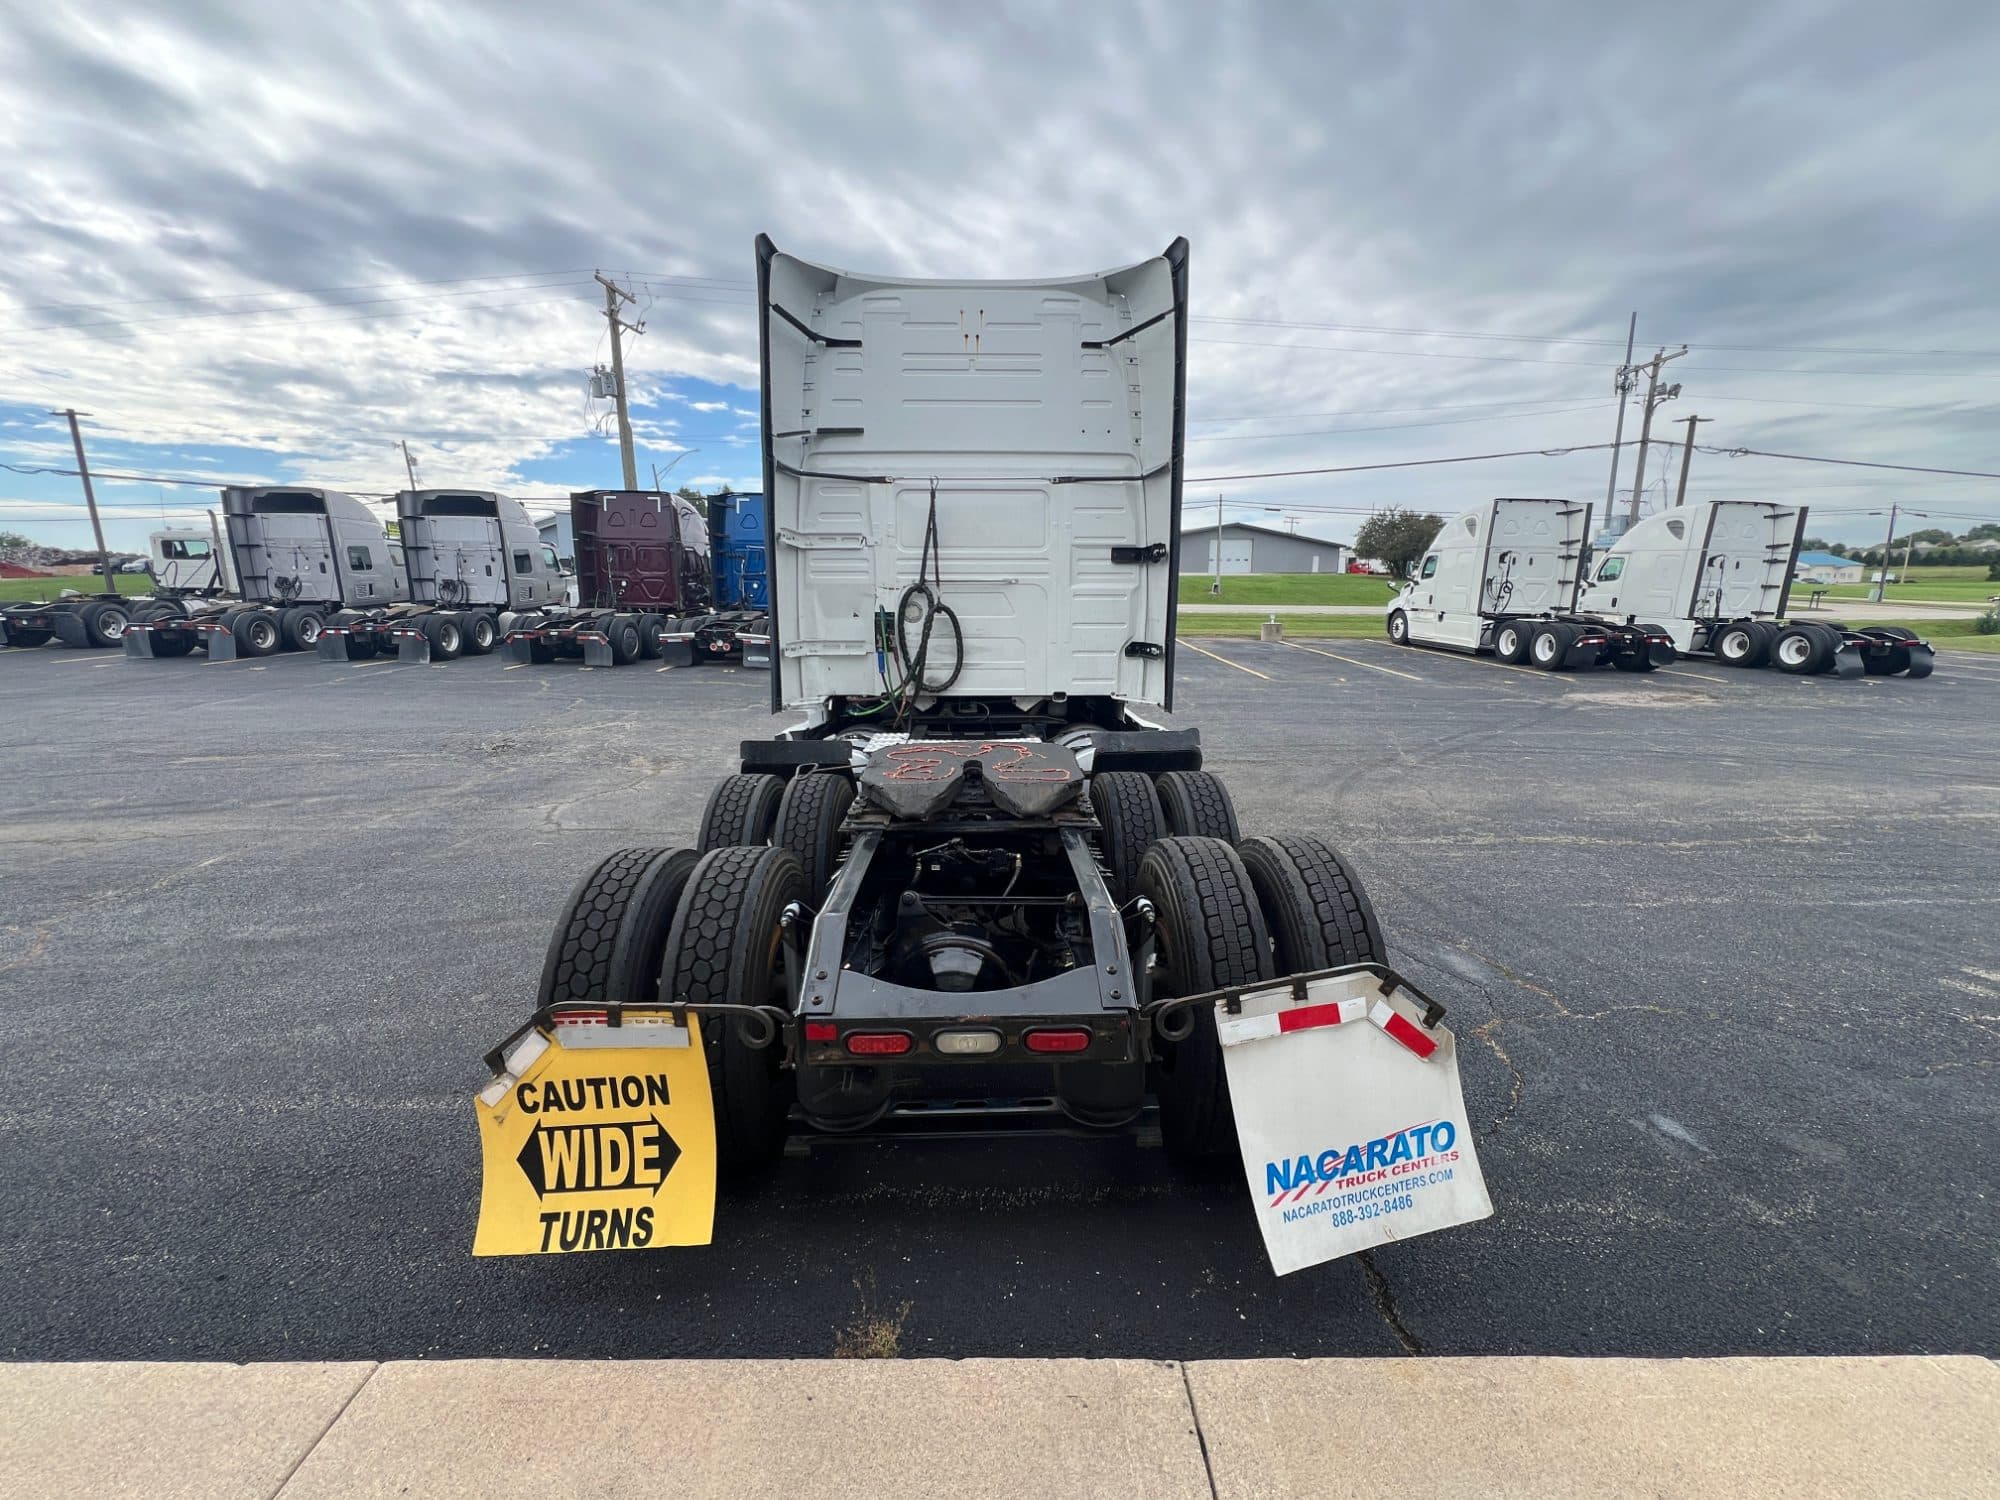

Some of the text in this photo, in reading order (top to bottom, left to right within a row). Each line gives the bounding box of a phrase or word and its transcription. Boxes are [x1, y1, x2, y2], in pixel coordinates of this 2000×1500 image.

[516, 1074, 670, 1114] CAUTION
[537, 1124, 661, 1190] WIDE
[1266, 1121, 1456, 1195] NACARATO
[1335, 1151, 1460, 1190] TRUCK CENTERS
[1283, 1169, 1453, 1224] NACARATOTRUCKCENTERS.COM
[1332, 1195, 1413, 1228] 888-392-8486
[539, 1207, 654, 1252] TURNS
